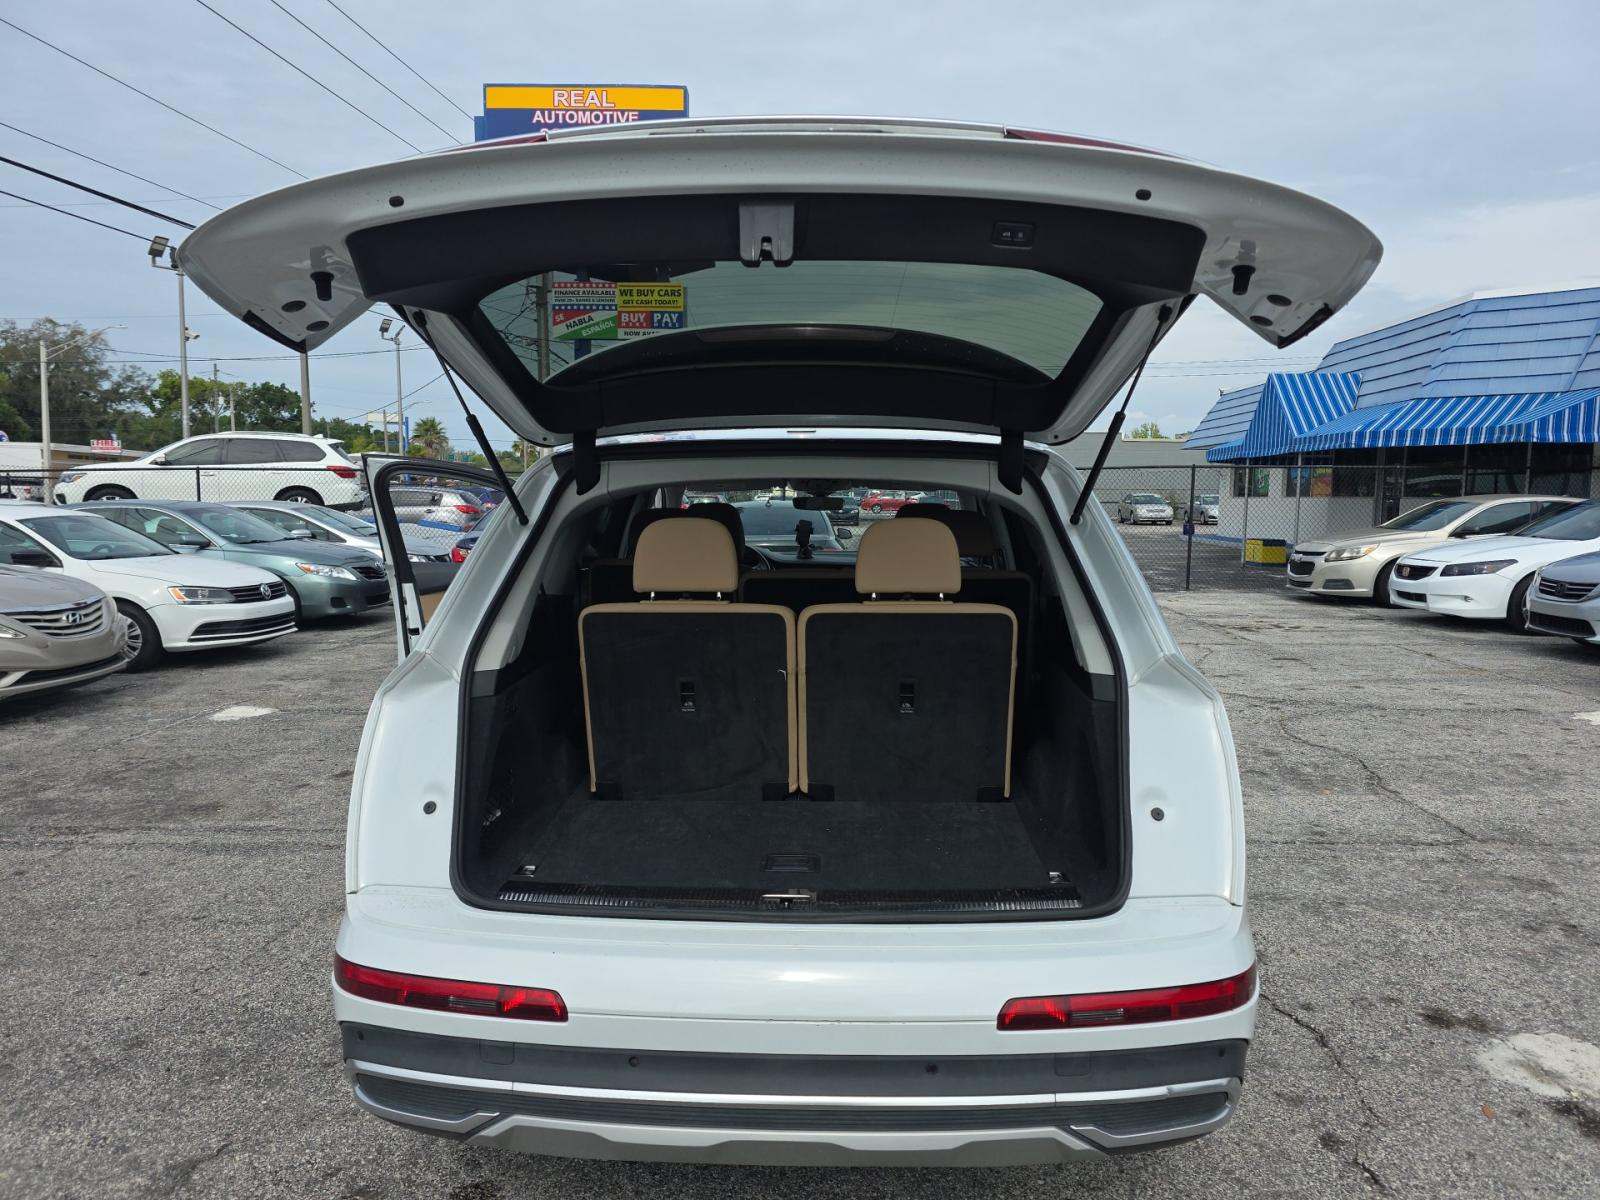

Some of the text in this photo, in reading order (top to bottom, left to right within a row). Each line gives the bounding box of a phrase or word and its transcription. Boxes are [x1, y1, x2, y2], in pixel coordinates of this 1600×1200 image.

[553, 89, 616, 108] REAL
[532, 110, 639, 125] AUTOMOTIVE
[619, 288, 682, 298] WE BUY CARS
[565, 315, 595, 330] HABLA
[621, 313, 647, 323] BUY
[653, 313, 680, 323] PAY
